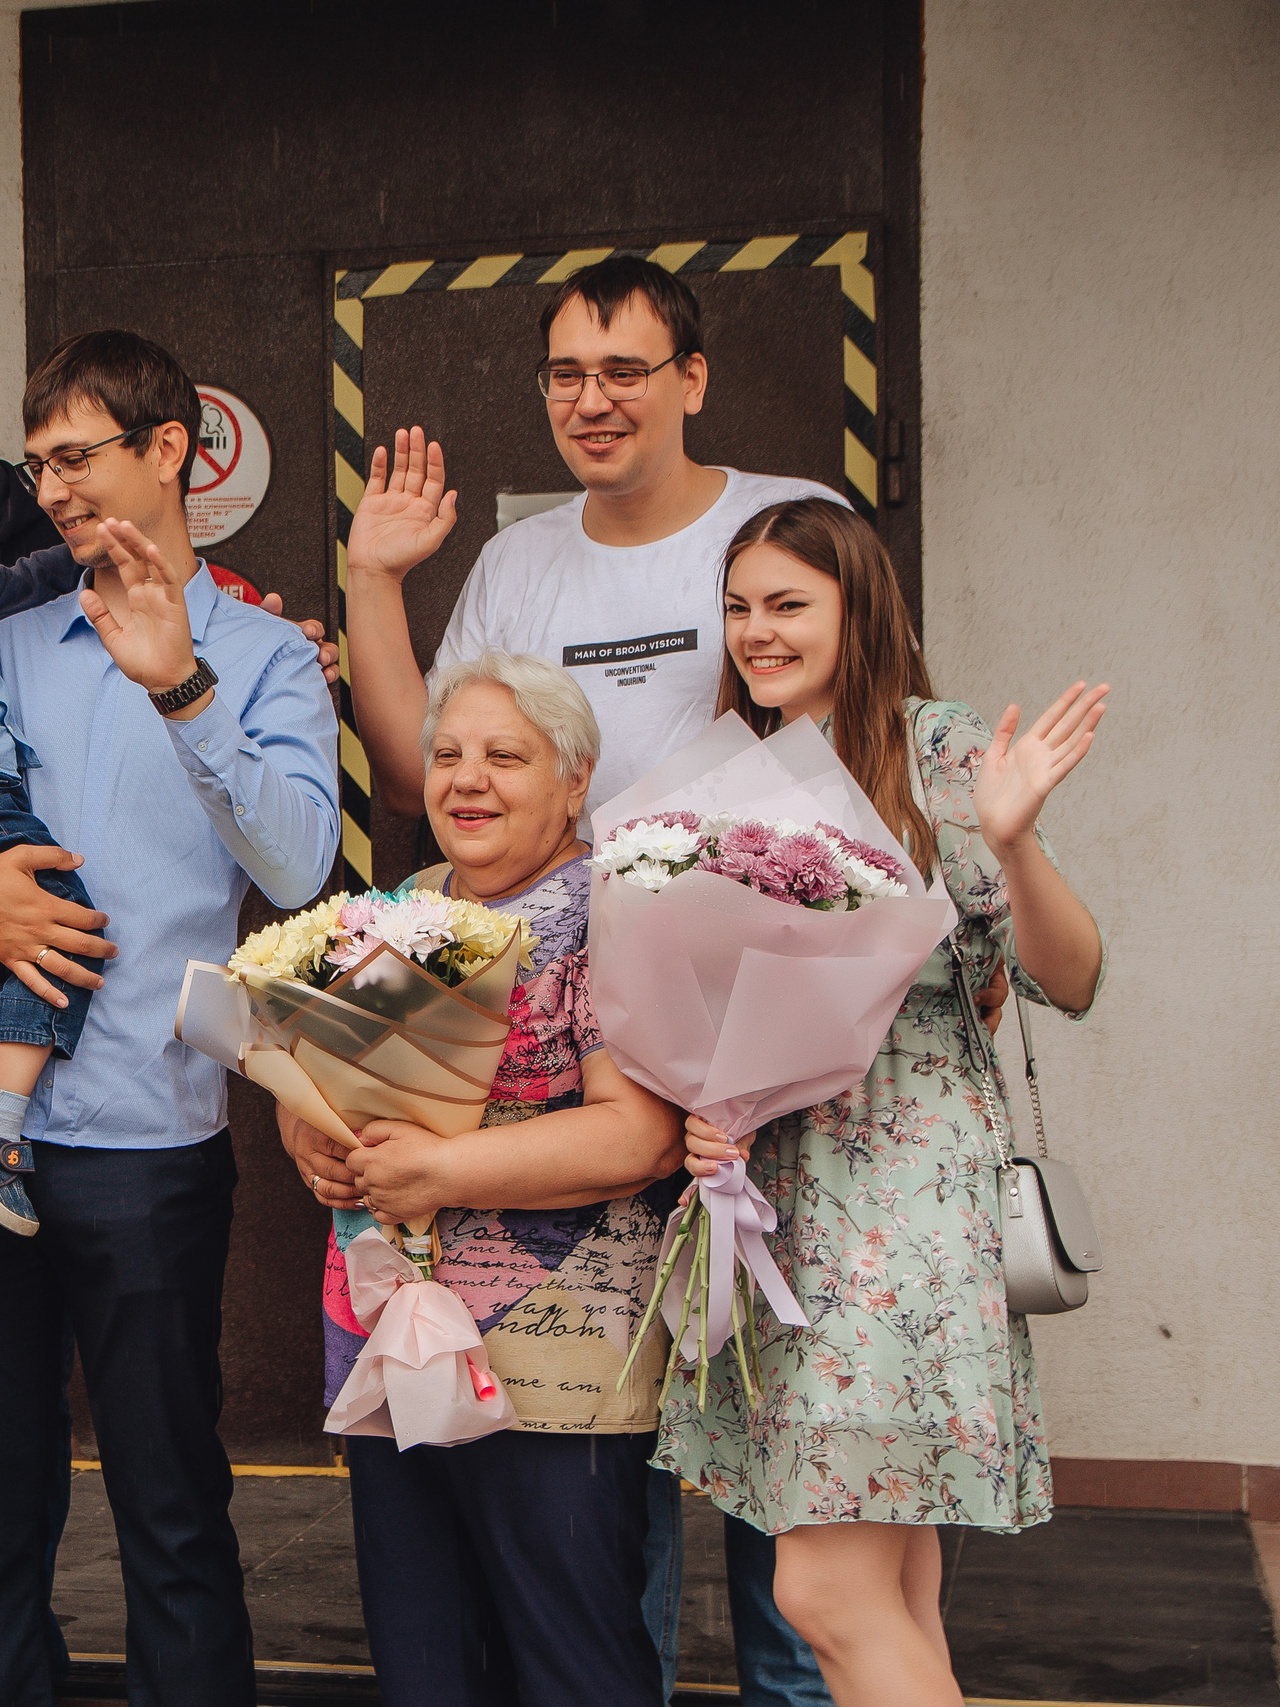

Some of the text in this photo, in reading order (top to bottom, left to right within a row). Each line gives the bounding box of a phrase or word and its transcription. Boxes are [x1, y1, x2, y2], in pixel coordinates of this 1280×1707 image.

[188, 524, 225, 532] РИЧЕСКИ
[574, 636, 685, 660] MAN OF BROAD VISION
[604, 662, 656, 677] UNCONVENTIONAL
